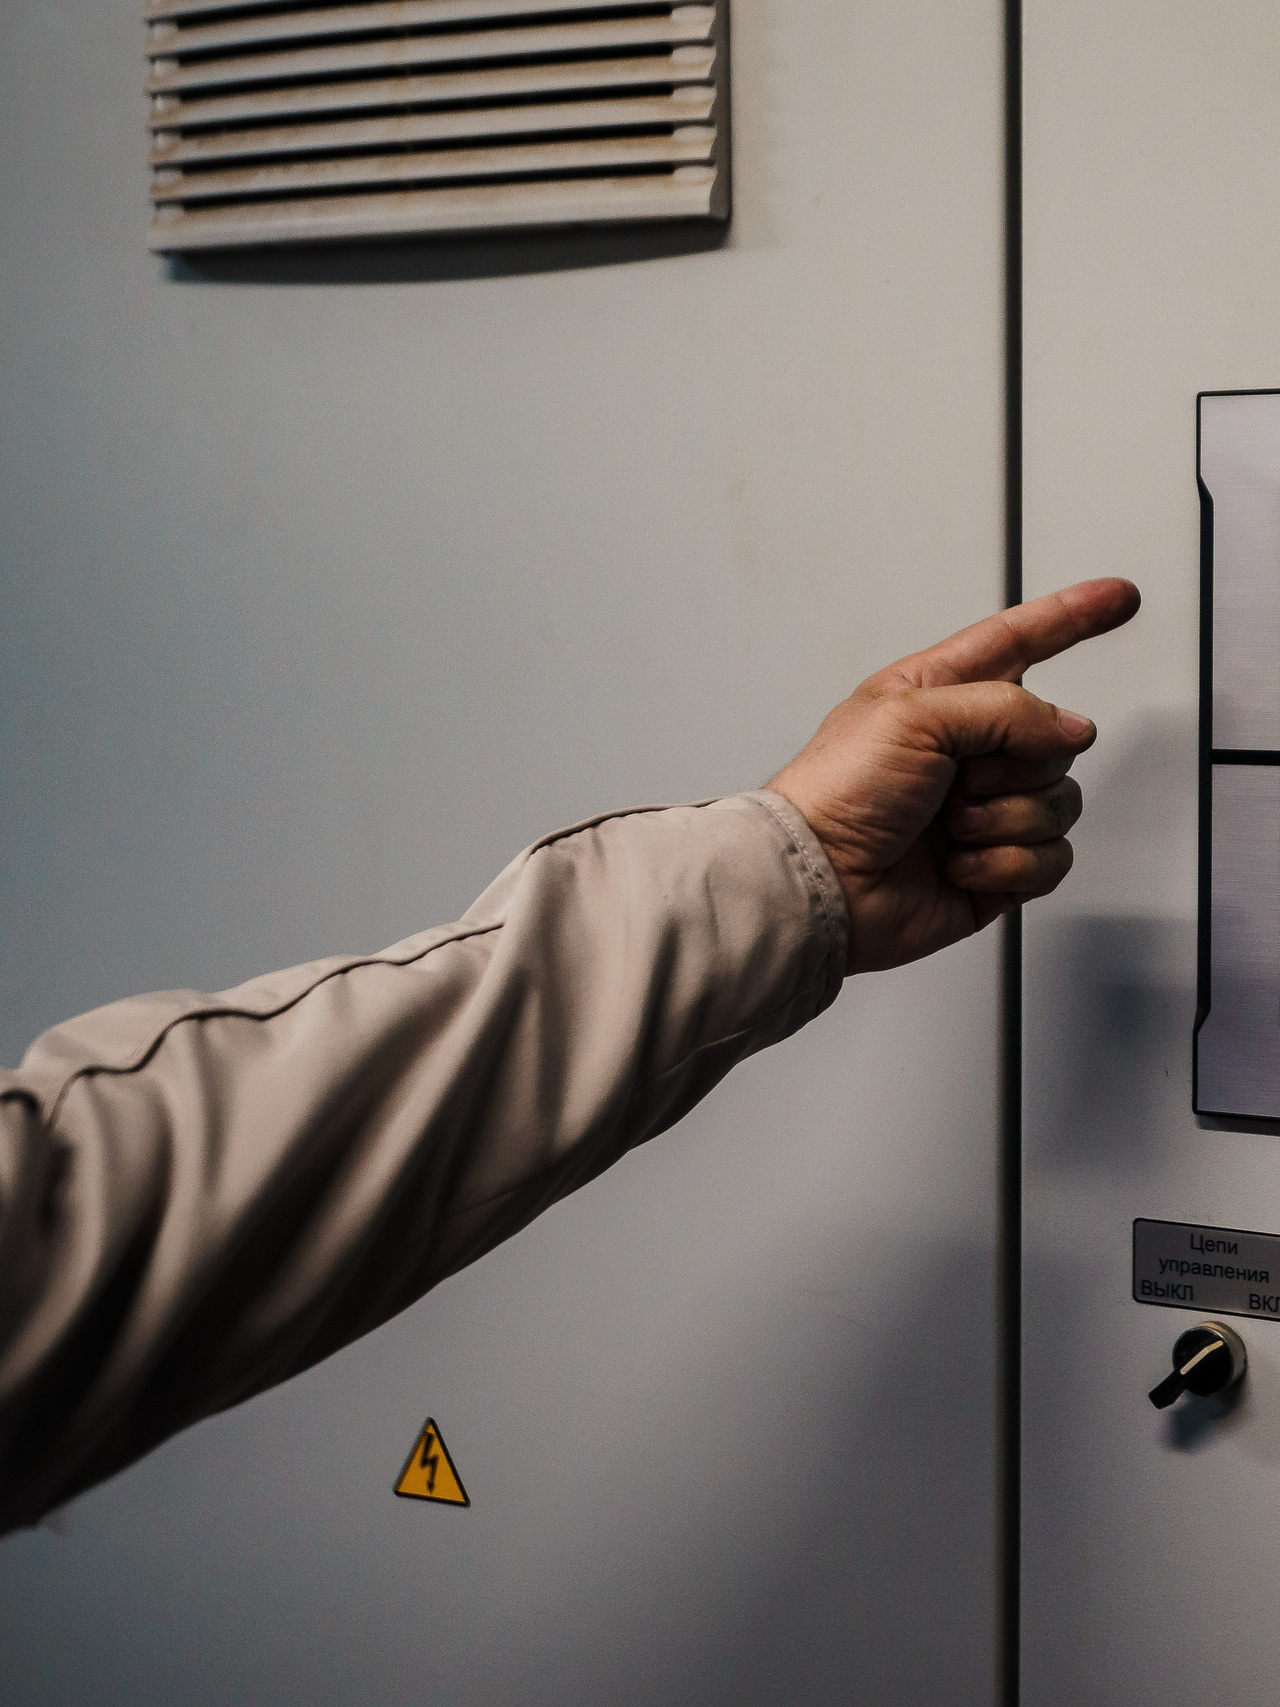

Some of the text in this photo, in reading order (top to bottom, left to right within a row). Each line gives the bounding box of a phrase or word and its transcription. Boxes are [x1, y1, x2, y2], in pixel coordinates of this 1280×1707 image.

[1190, 1233, 1239, 1255] Цепи
[1159, 1256, 1270, 1284] управления
[1141, 1280, 1194, 1301] ВЫКЛ
